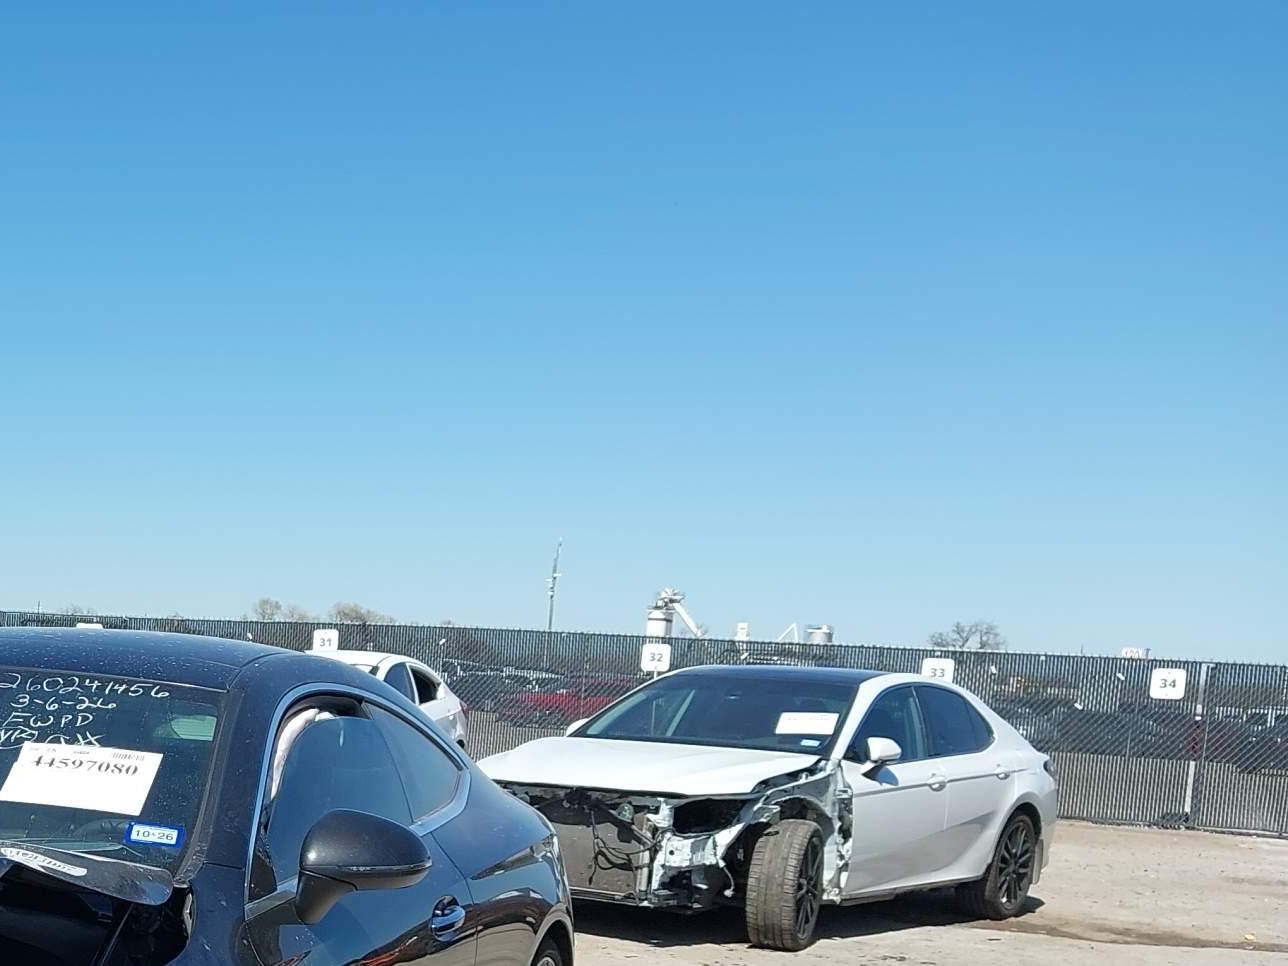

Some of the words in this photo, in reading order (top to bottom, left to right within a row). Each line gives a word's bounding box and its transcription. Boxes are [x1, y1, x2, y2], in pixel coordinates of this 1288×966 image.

[319, 638, 332, 647] 31
[649, 652, 663, 662] 32
[930, 668, 945, 678] 33
[1159, 678, 1177, 689] 34
[10, 694, 117, 710] 3-6-26
[33, 755, 138, 775] 44597080
